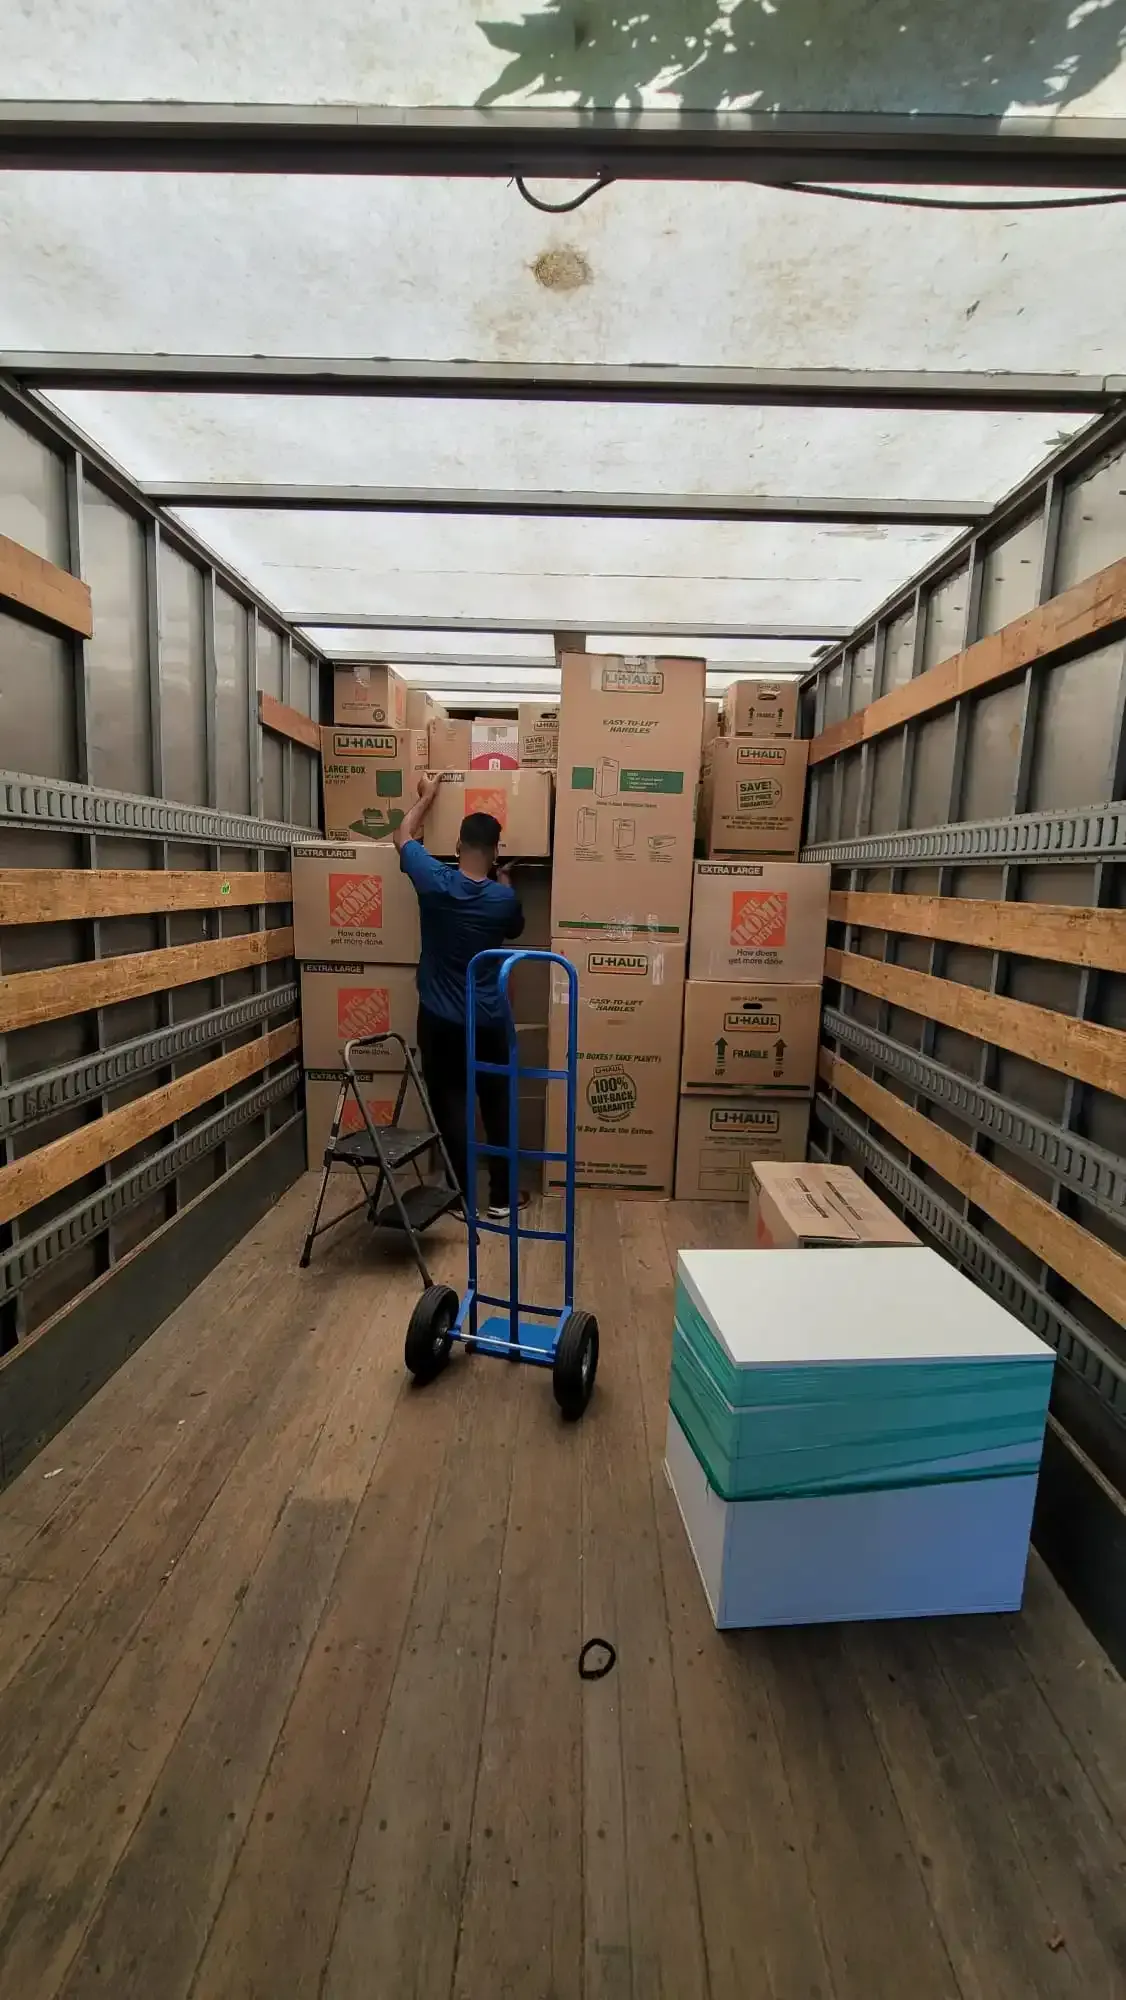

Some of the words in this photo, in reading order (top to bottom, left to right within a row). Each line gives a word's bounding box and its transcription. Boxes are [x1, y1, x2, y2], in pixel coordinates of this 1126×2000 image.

[606, 672, 660, 685] U-HAUL
[603, 719, 659, 727] EASY-TO-LIFT
[609, 726, 651, 734] HANDLES
[336, 736, 393, 749] U-HAUL
[740, 749, 783, 759] U-HAUL
[324, 765, 349, 774] LARGE
[351, 765, 366, 774] BOX
[740, 781, 772, 792] SAVE!
[296, 848, 323, 857] EXTRA
[326, 849, 354, 858] LARGE
[701, 864, 730, 874] EXTRA
[732, 865, 761, 875] LARGE
[336, 880, 355, 899] THE
[331, 875, 381, 926] HOME
[351, 894, 382, 927] DEPOT
[739, 899, 760, 919] THE
[731, 893, 785, 945] HOME
[338, 929, 353, 937] How
[356, 929, 377, 938] doers
[751, 914, 785, 946] DEPOT
[755, 948, 777, 957] doers
[592, 956, 645, 967] U-HAUL
[728, 957, 741, 965] get
[306, 964, 333, 972] EXTRA
[335, 965, 361, 973] LARGE
[589, 998, 644, 1006] EASY-TO-LIFT
[728, 1015, 777, 1025] U-HAUL
[733, 1050, 768, 1059] FRAGILE
[595, 1064, 621, 1074] U-HAUL
[311, 1072, 336, 1080] EXTRA
[593, 1076, 628, 1093] 100%
[591, 1091, 633, 1105] BUY-BACK
[592, 1100, 635, 1114] GUARANTEE
[715, 1112, 775, 1124] U-HAUL
